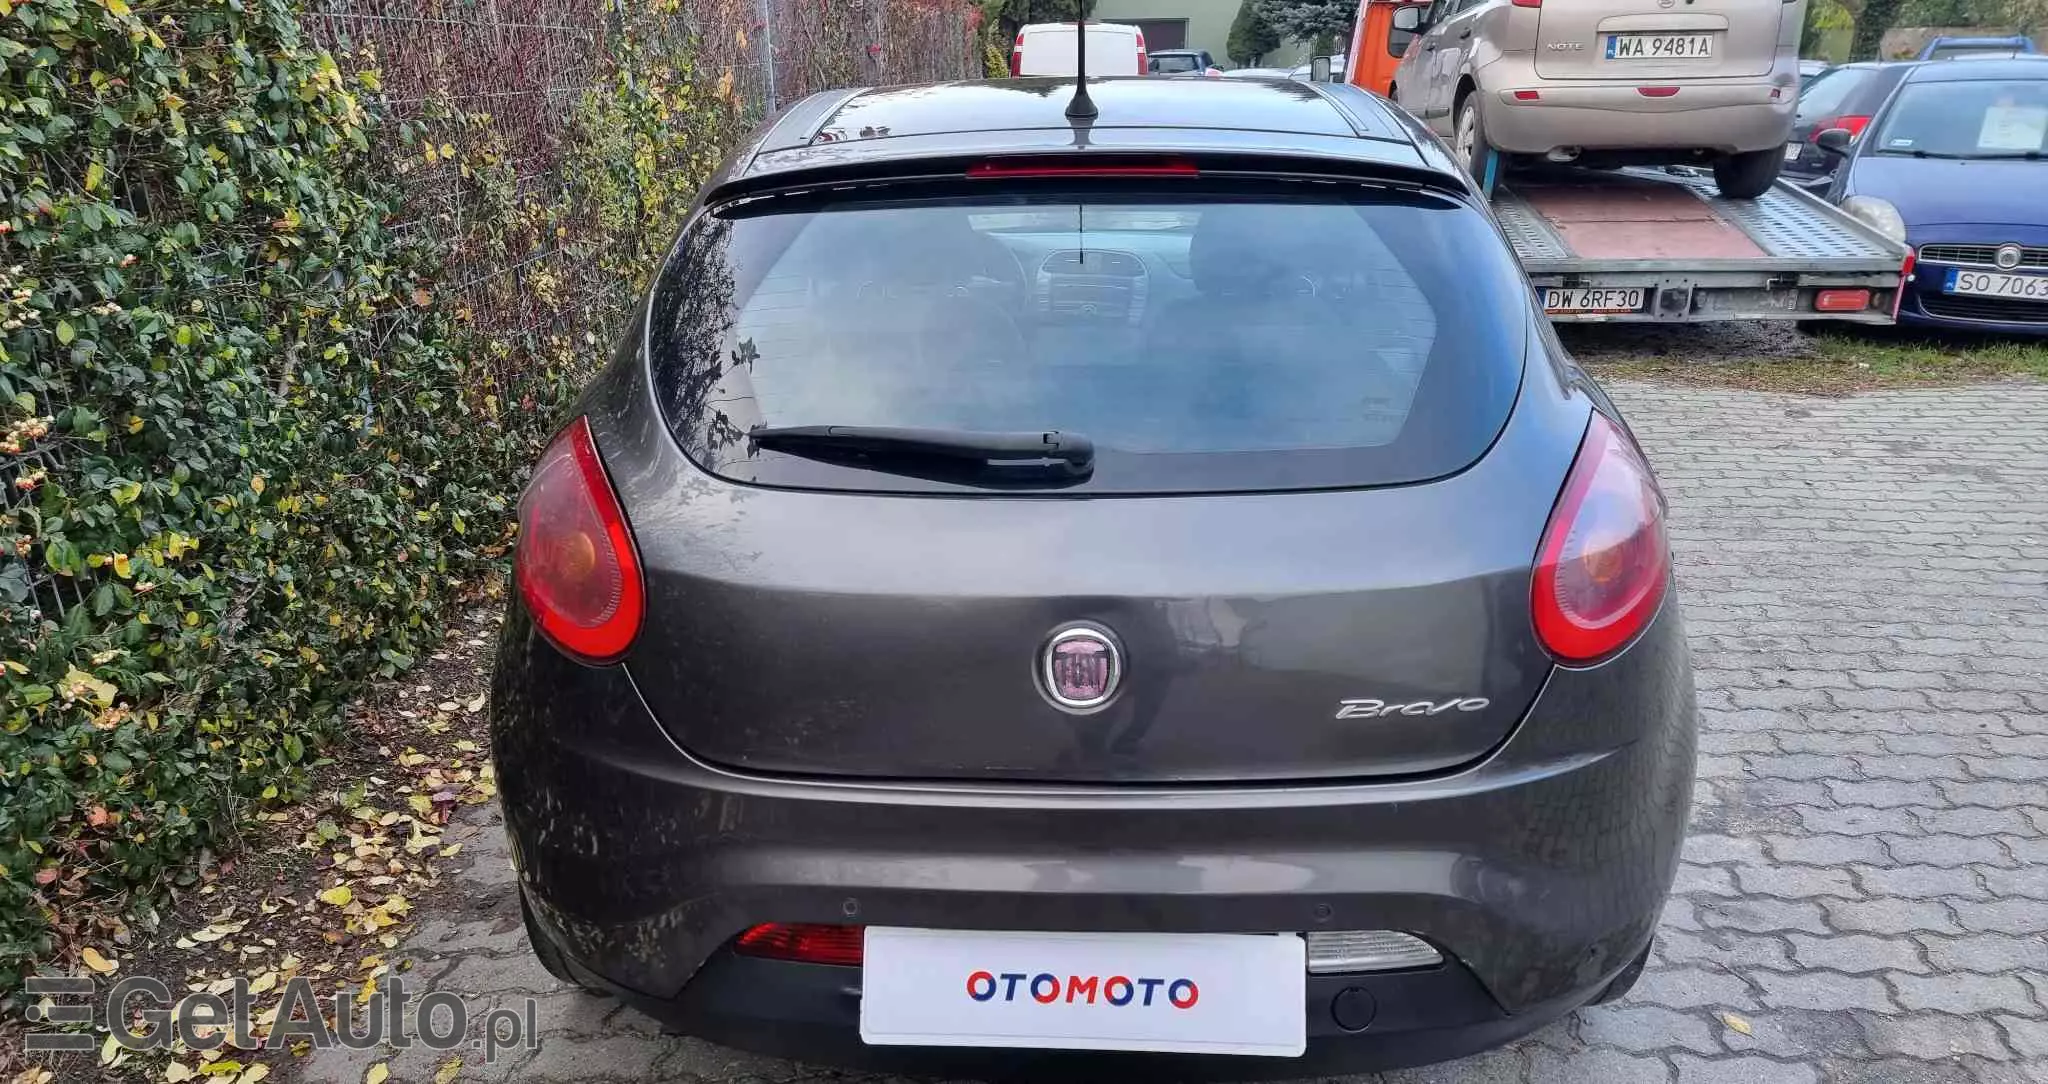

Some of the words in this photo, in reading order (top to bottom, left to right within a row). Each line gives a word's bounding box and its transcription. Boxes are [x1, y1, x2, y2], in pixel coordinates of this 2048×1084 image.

[1619, 38, 1644, 56] WA
[1652, 38, 1709, 56] 9481A
[1959, 273, 1991, 292] SO
[1998, 276, 2048, 296] 7063
[1548, 290, 1574, 308] DW
[1580, 290, 1639, 308] 6RF30
[1335, 697, 1490, 719] Bravo
[966, 970, 1199, 1009] OTOMOTO
